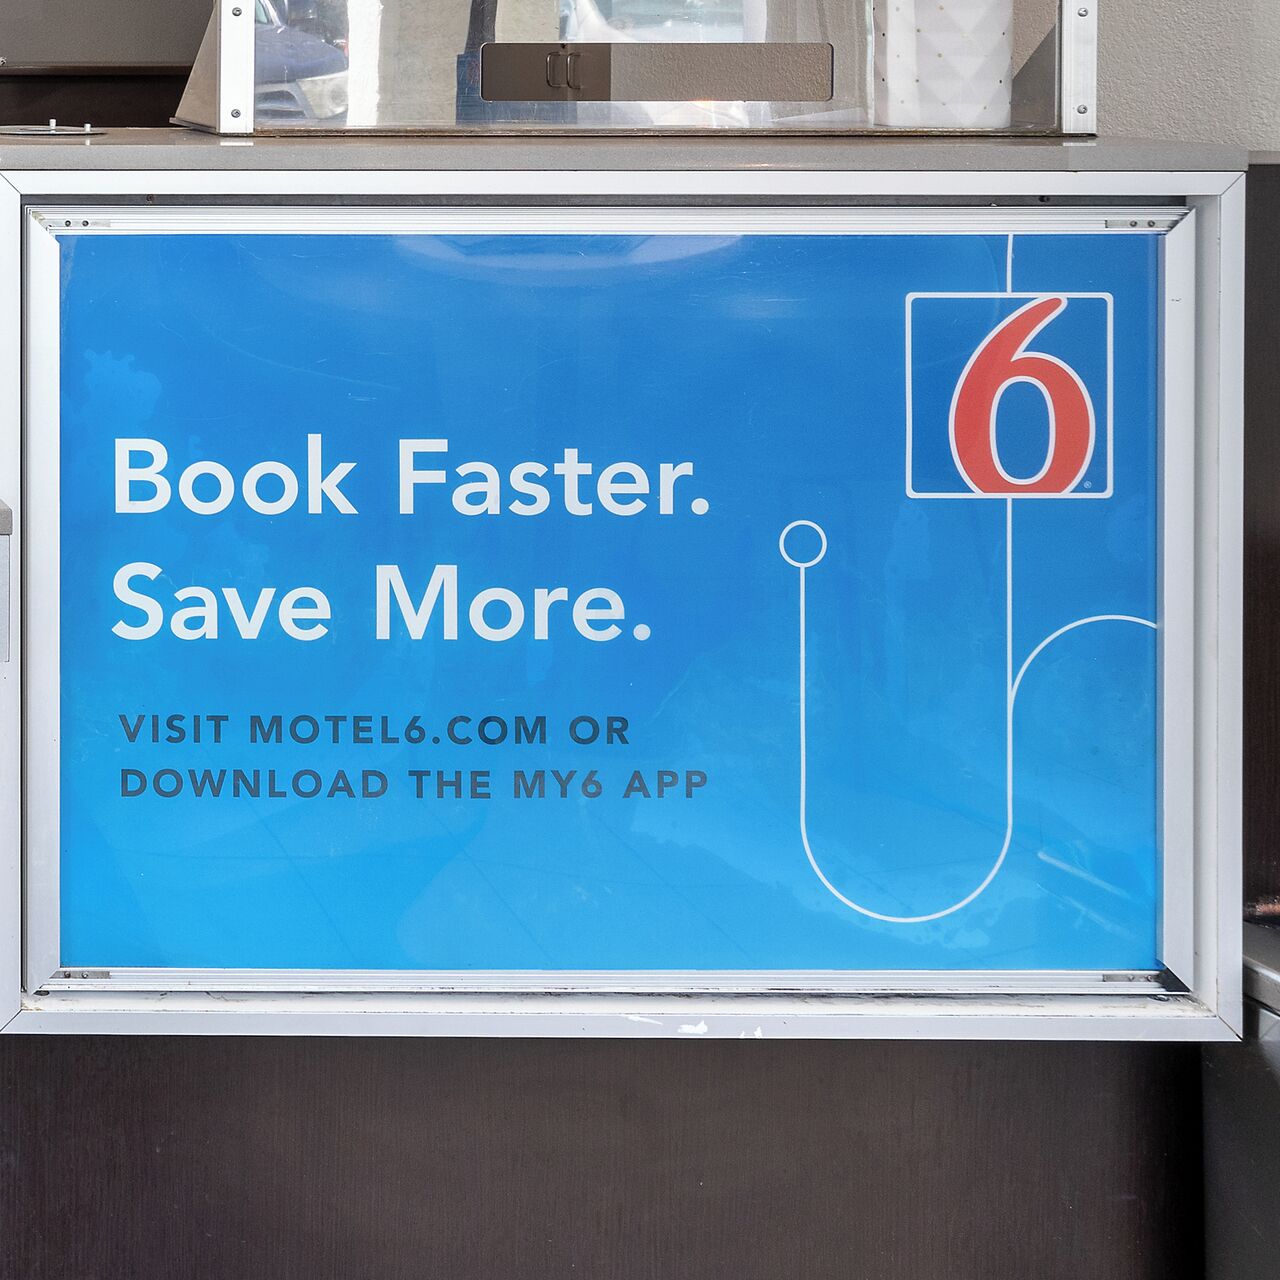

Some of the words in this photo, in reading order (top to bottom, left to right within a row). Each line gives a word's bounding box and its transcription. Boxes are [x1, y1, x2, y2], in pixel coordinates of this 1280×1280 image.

[949, 295, 1096, 496] 6
[113, 434, 358, 516] Book
[399, 439, 711, 516] Faster.
[111, 562, 333, 642] Save
[375, 565, 653, 642] More.
[119, 715, 227, 745] VISIT
[251, 714, 548, 746] MOTEL6.COM
[569, 714, 631, 746] OR
[120, 768, 391, 800] DOWNLOAD
[408, 769, 494, 800] THE
[512, 769, 604, 800] MY6
[623, 769, 710, 800] APP
